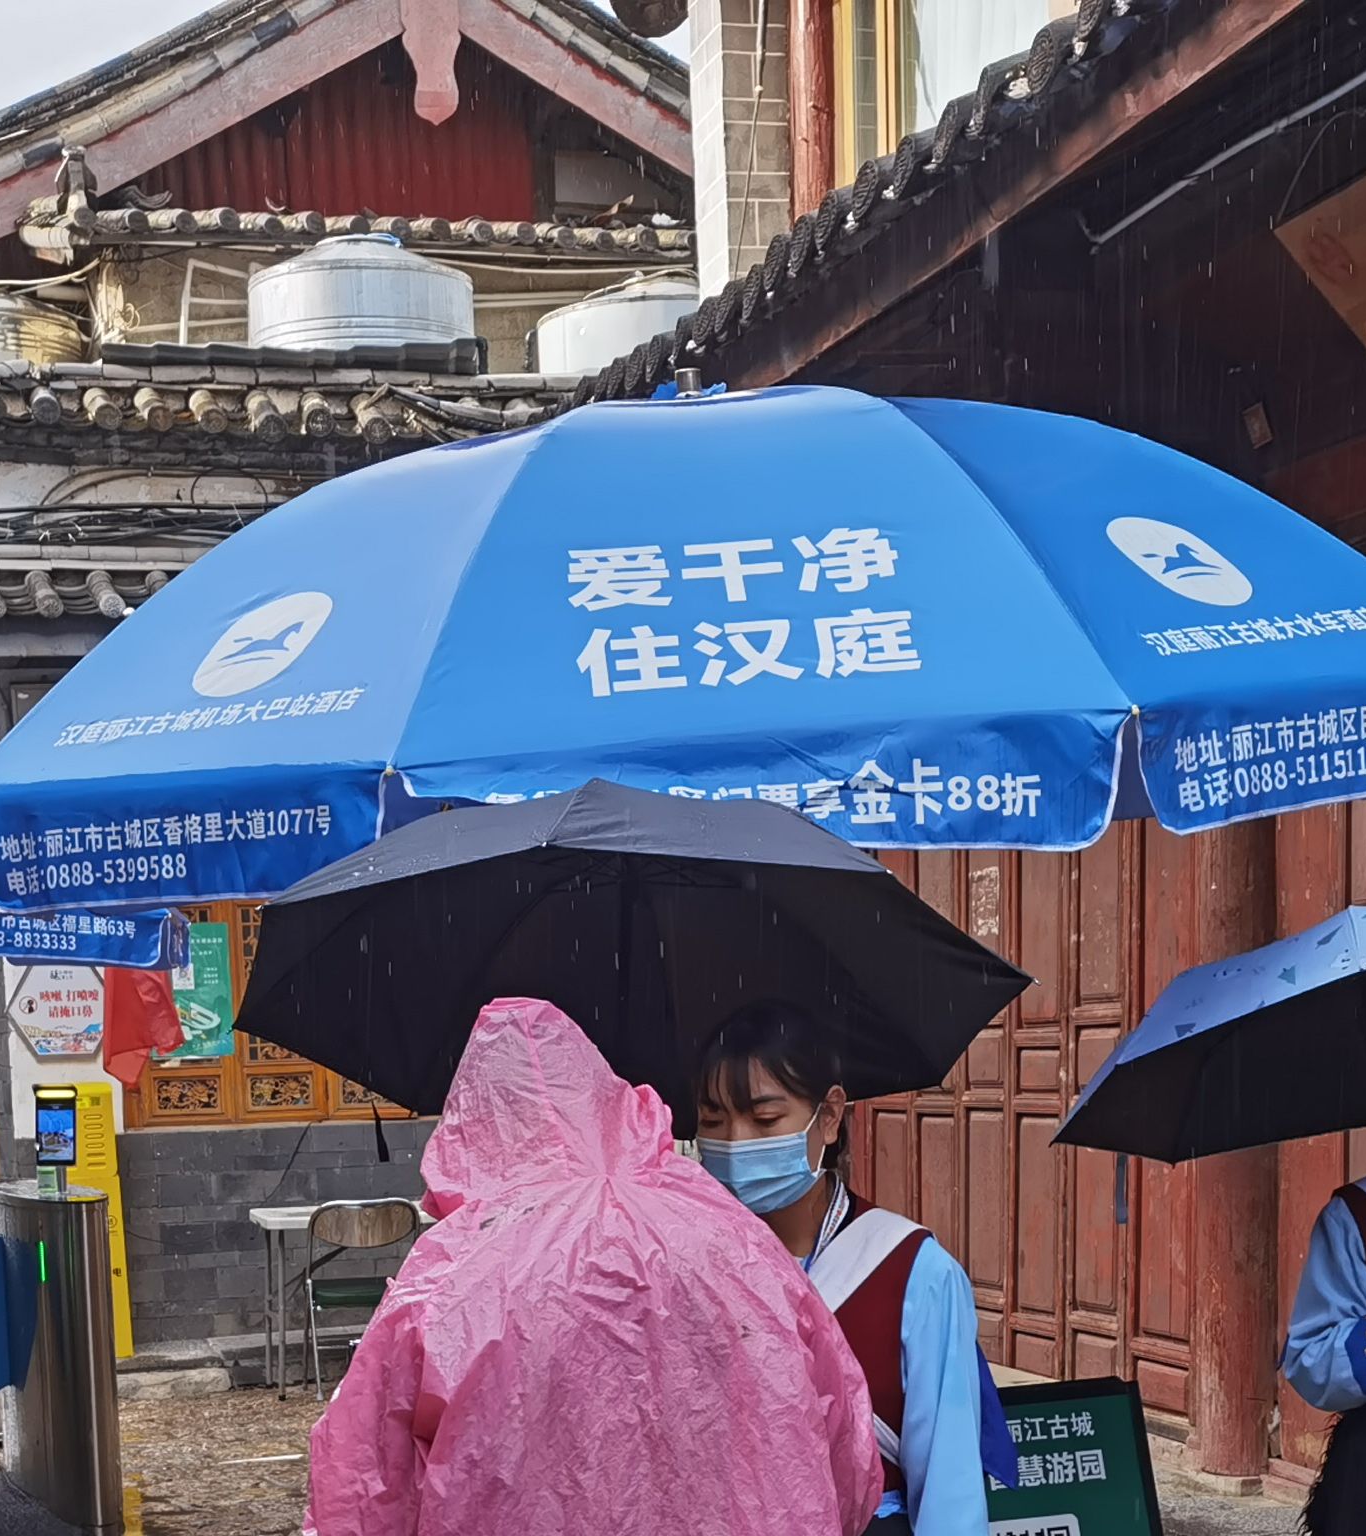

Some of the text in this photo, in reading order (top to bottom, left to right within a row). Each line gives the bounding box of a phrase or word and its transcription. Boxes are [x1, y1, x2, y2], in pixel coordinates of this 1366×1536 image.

[567, 526, 899, 612] 爱干净
[576, 607, 923, 698] 住汉庭
[53, 686, 365, 748] 汉庭丽江古城机场大巴站酒店
[0, 804, 332, 863] 地址:丽江市古城区香格里大道1077号
[6, 852, 187, 897] 电话:0888-5399588
[989, 1449, 1108, 1491] 慧游园
